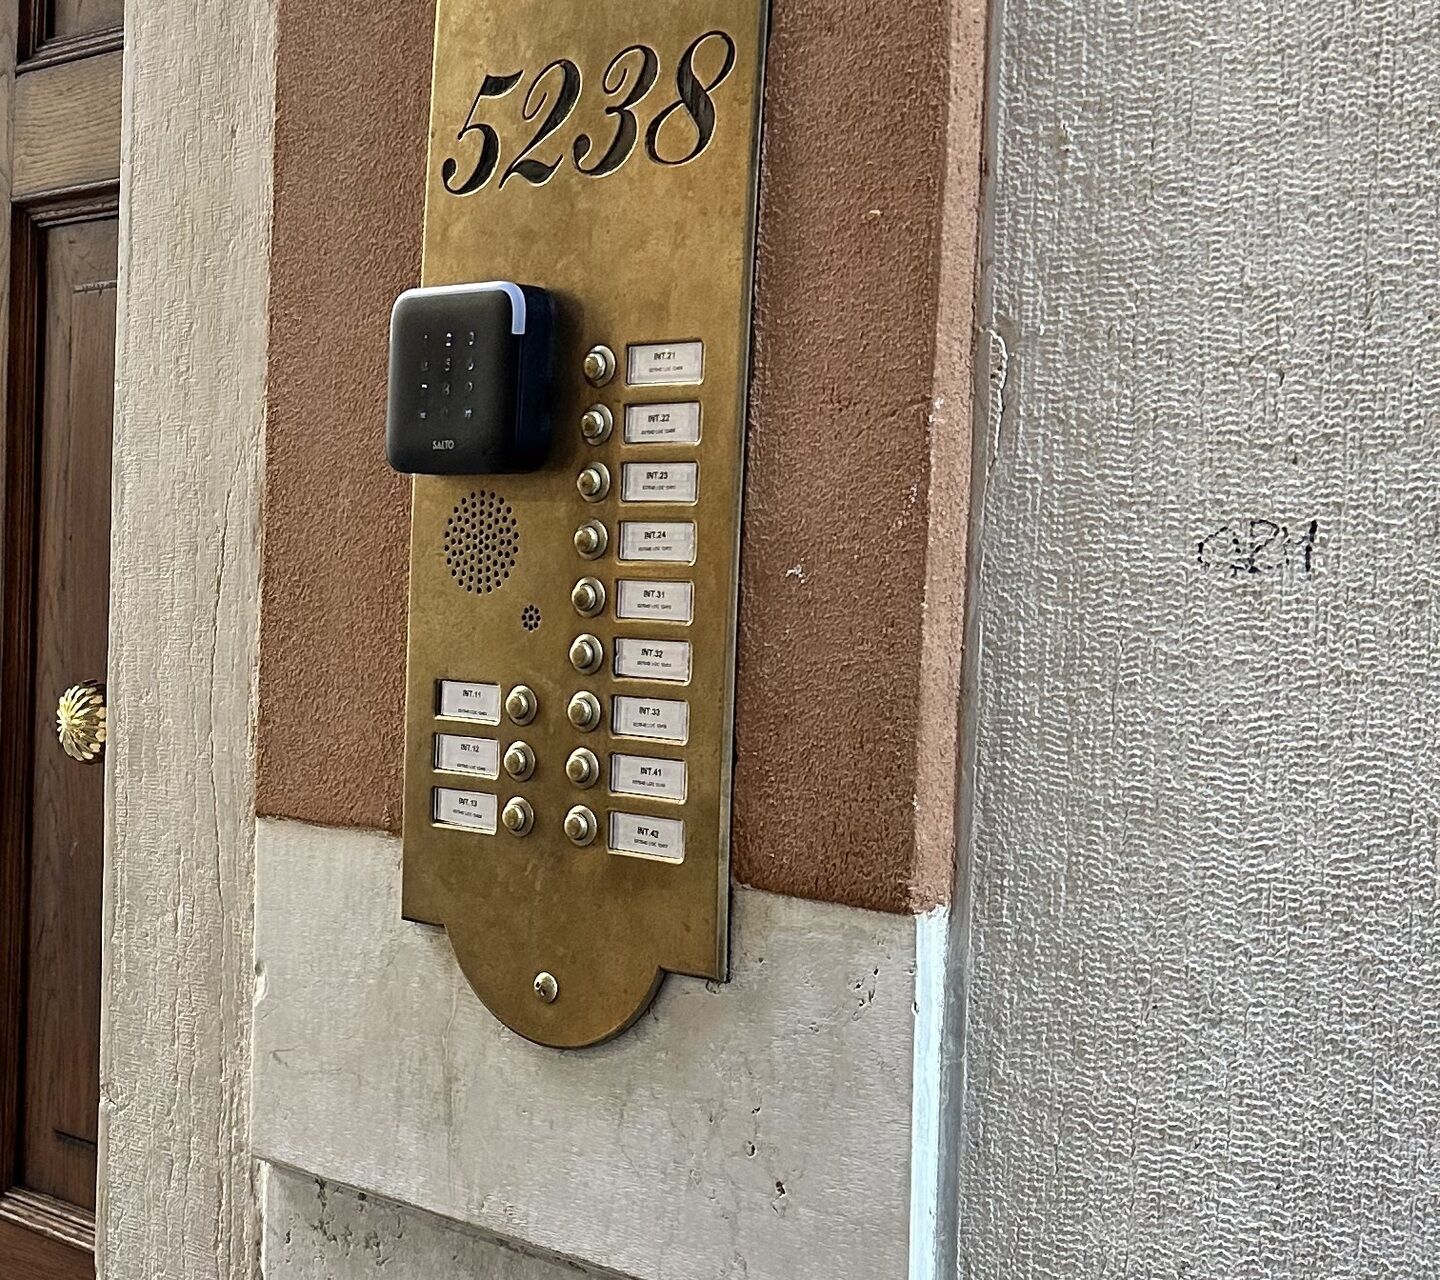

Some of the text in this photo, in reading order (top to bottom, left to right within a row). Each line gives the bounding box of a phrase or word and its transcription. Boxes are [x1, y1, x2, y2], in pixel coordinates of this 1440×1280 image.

[442, 29, 737, 197] 5238
[653, 351, 676, 361] INT.21
[647, 413, 670, 423] INT.22
[646, 471, 668, 480] INT.23
[644, 530, 667, 540] INT.24
[643, 589, 665, 599] INT.31
[641, 647, 664, 659] INT.32
[639, 706, 661, 717] INT.33
[640, 766, 662, 777] INT.41
